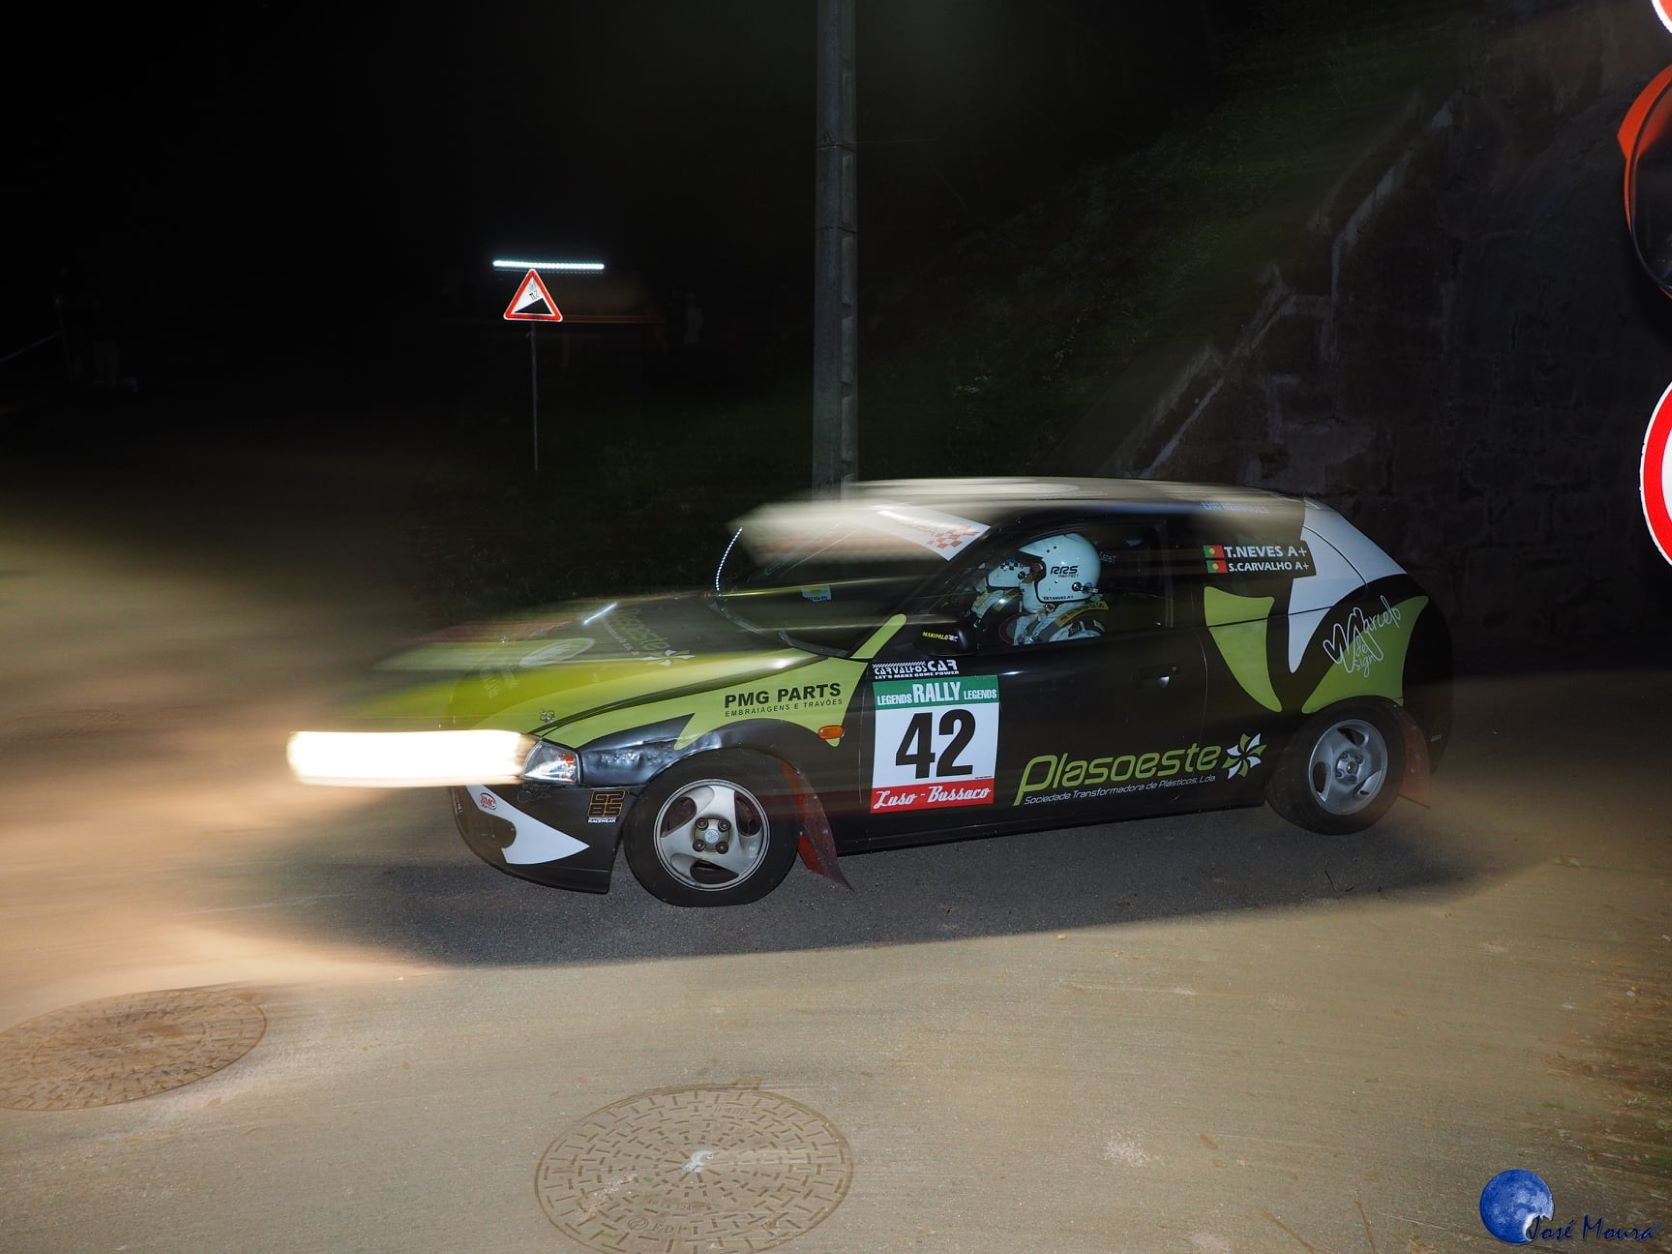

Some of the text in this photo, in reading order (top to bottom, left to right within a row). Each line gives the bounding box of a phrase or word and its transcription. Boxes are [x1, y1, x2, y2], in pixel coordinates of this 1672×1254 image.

[1223, 545, 1307, 558] T.NEVES A+
[1050, 565, 1079, 575] RRS
[1228, 561, 1309, 572] S.CARVALHO A+
[724, 683, 842, 709] PMG PARTS
[876, 681, 997, 705] LEGENDS RALLY LEGENDS
[724, 704, 790, 718] EMBRAIAGENS
[803, 698, 843, 709] TRAVÕES
[895, 708, 976, 780] 42
[1012, 743, 1222, 807] Plasoeste
[872, 790, 918, 809] Luso
[927, 785, 992, 803] Bussaco
